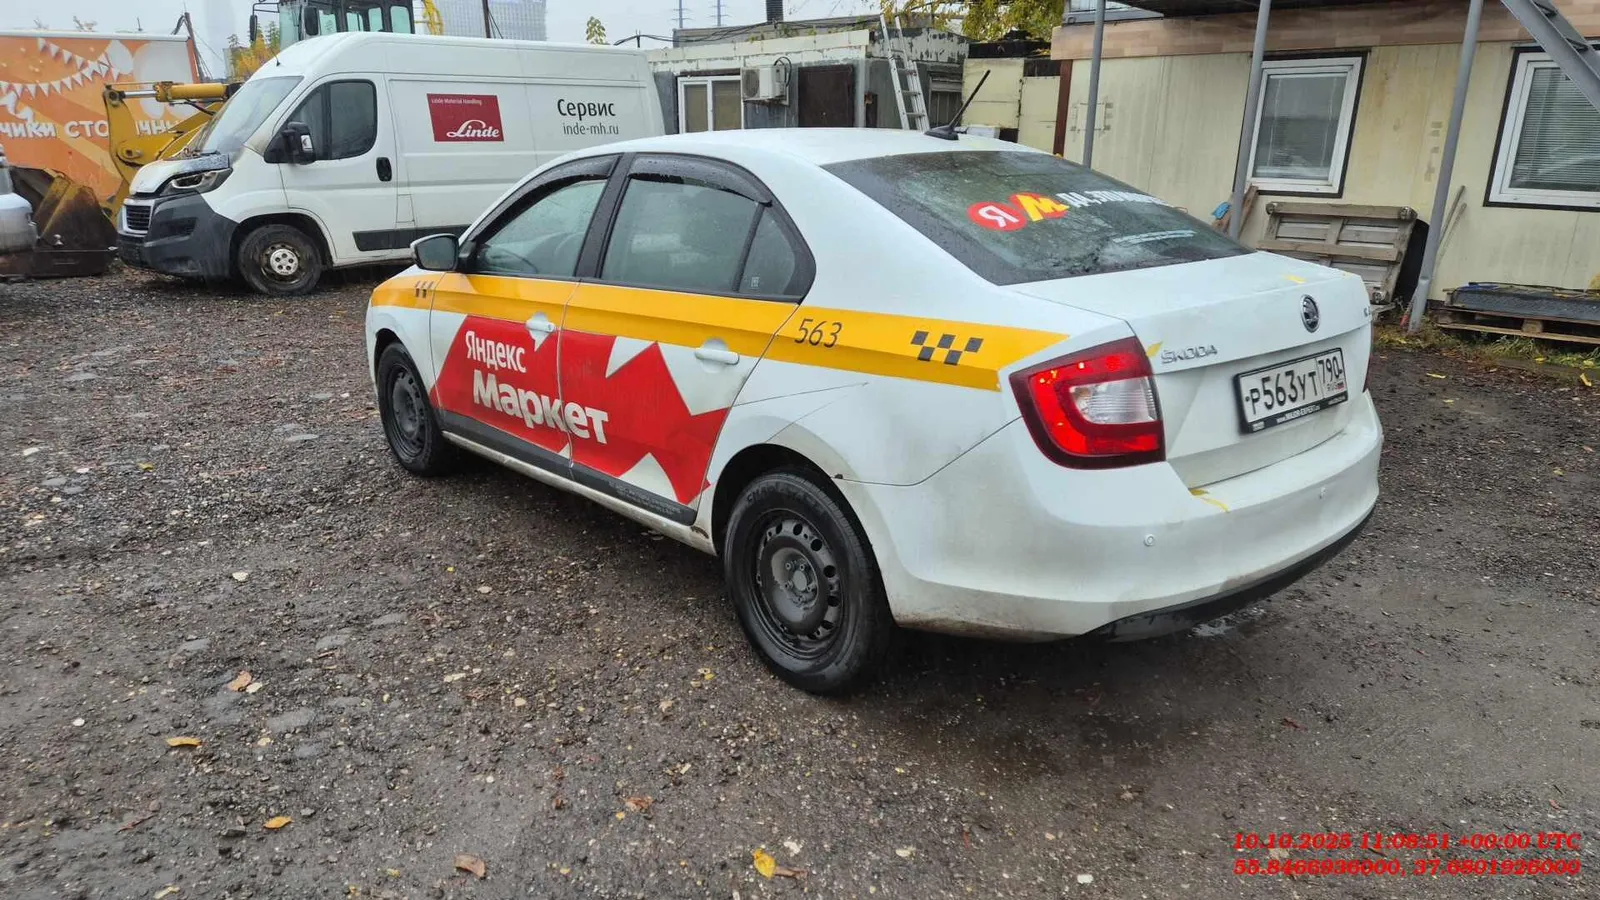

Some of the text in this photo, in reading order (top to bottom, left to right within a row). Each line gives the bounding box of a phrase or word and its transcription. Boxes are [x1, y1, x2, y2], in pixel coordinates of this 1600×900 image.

[557, 98, 616, 121] Сервис
[446, 119, 500, 138] Linde
[562, 121, 619, 135] inde-mh.ru
[794, 317, 843, 348] 563
[464, 330, 527, 374] Яндекс
[472, 368, 609, 445] Маркет
